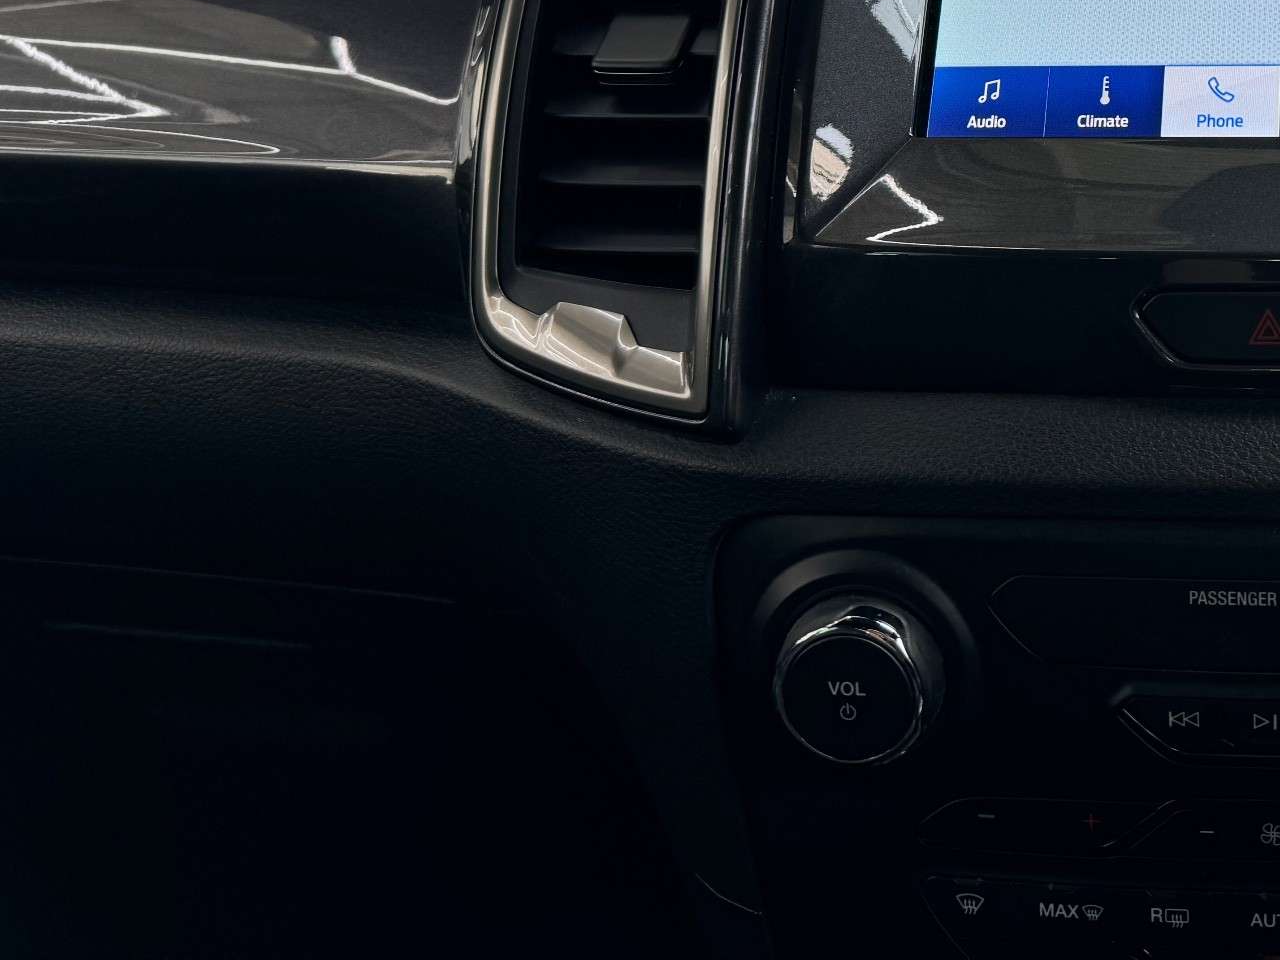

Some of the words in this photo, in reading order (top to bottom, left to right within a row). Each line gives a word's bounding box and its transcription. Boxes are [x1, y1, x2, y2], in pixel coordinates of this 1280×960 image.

[966, 115, 1007, 129] Audio
[1077, 114, 1129, 129] Climate
[1196, 114, 1244, 128] Phone
[1188, 590, 1278, 606] PASSENGER
[827, 680, 868, 696] VOL
[1039, 902, 1080, 919] MAX
[1150, 907, 1164, 923] R
